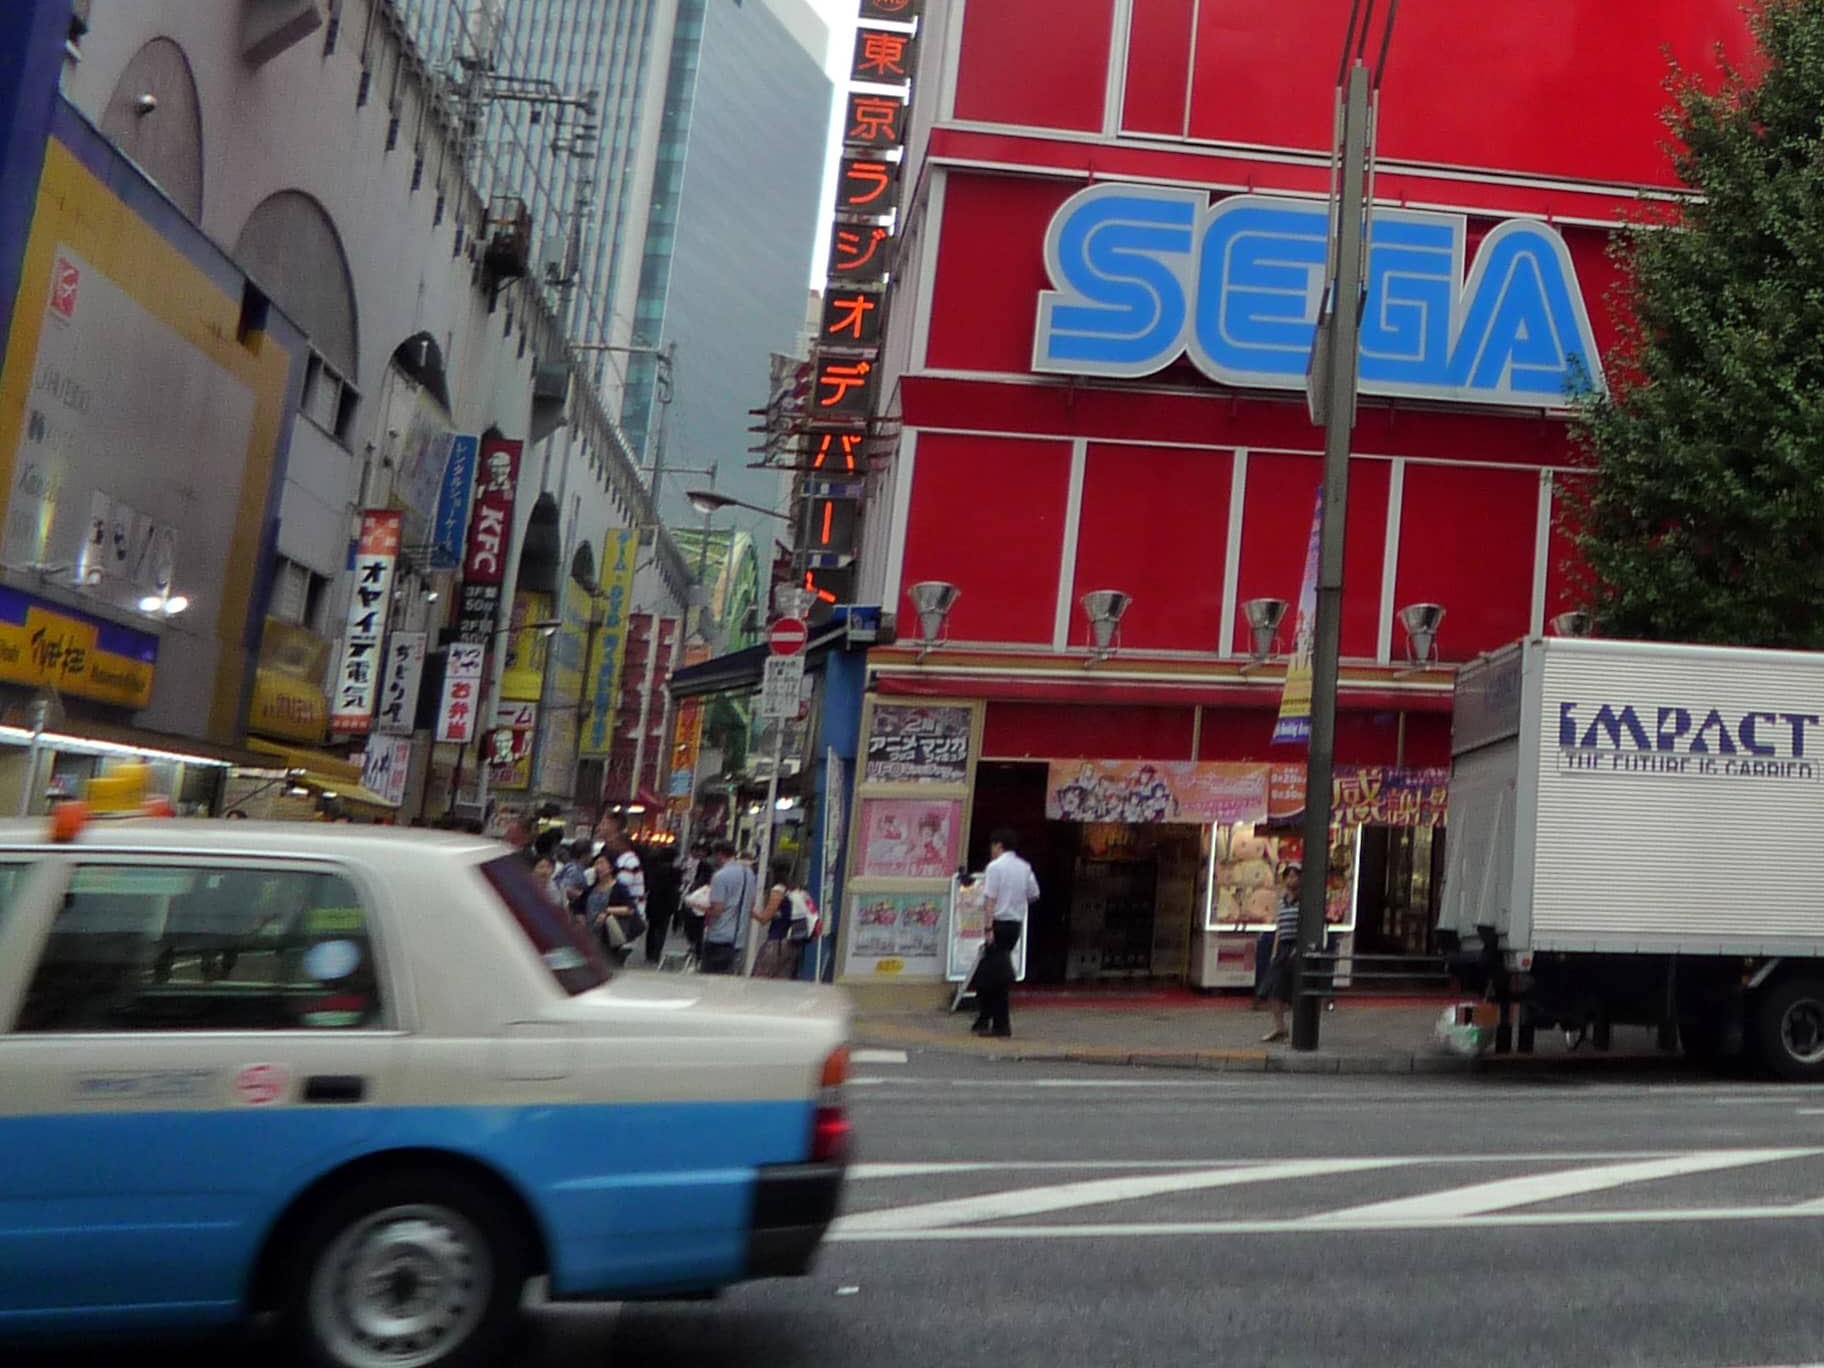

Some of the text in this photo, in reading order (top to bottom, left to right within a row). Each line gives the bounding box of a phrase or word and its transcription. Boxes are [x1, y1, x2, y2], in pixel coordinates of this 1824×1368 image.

[805, 35, 907, 605] 東京ラジオデパート
[1031, 182, 1609, 408] SEGA
[472, 504, 504, 576] KFC
[342, 561, 388, 710] オヤイデ電気
[446, 680, 472, 739] お弁当
[1559, 702, 1819, 758] IMPACT
[1566, 753, 1604, 771] THE
